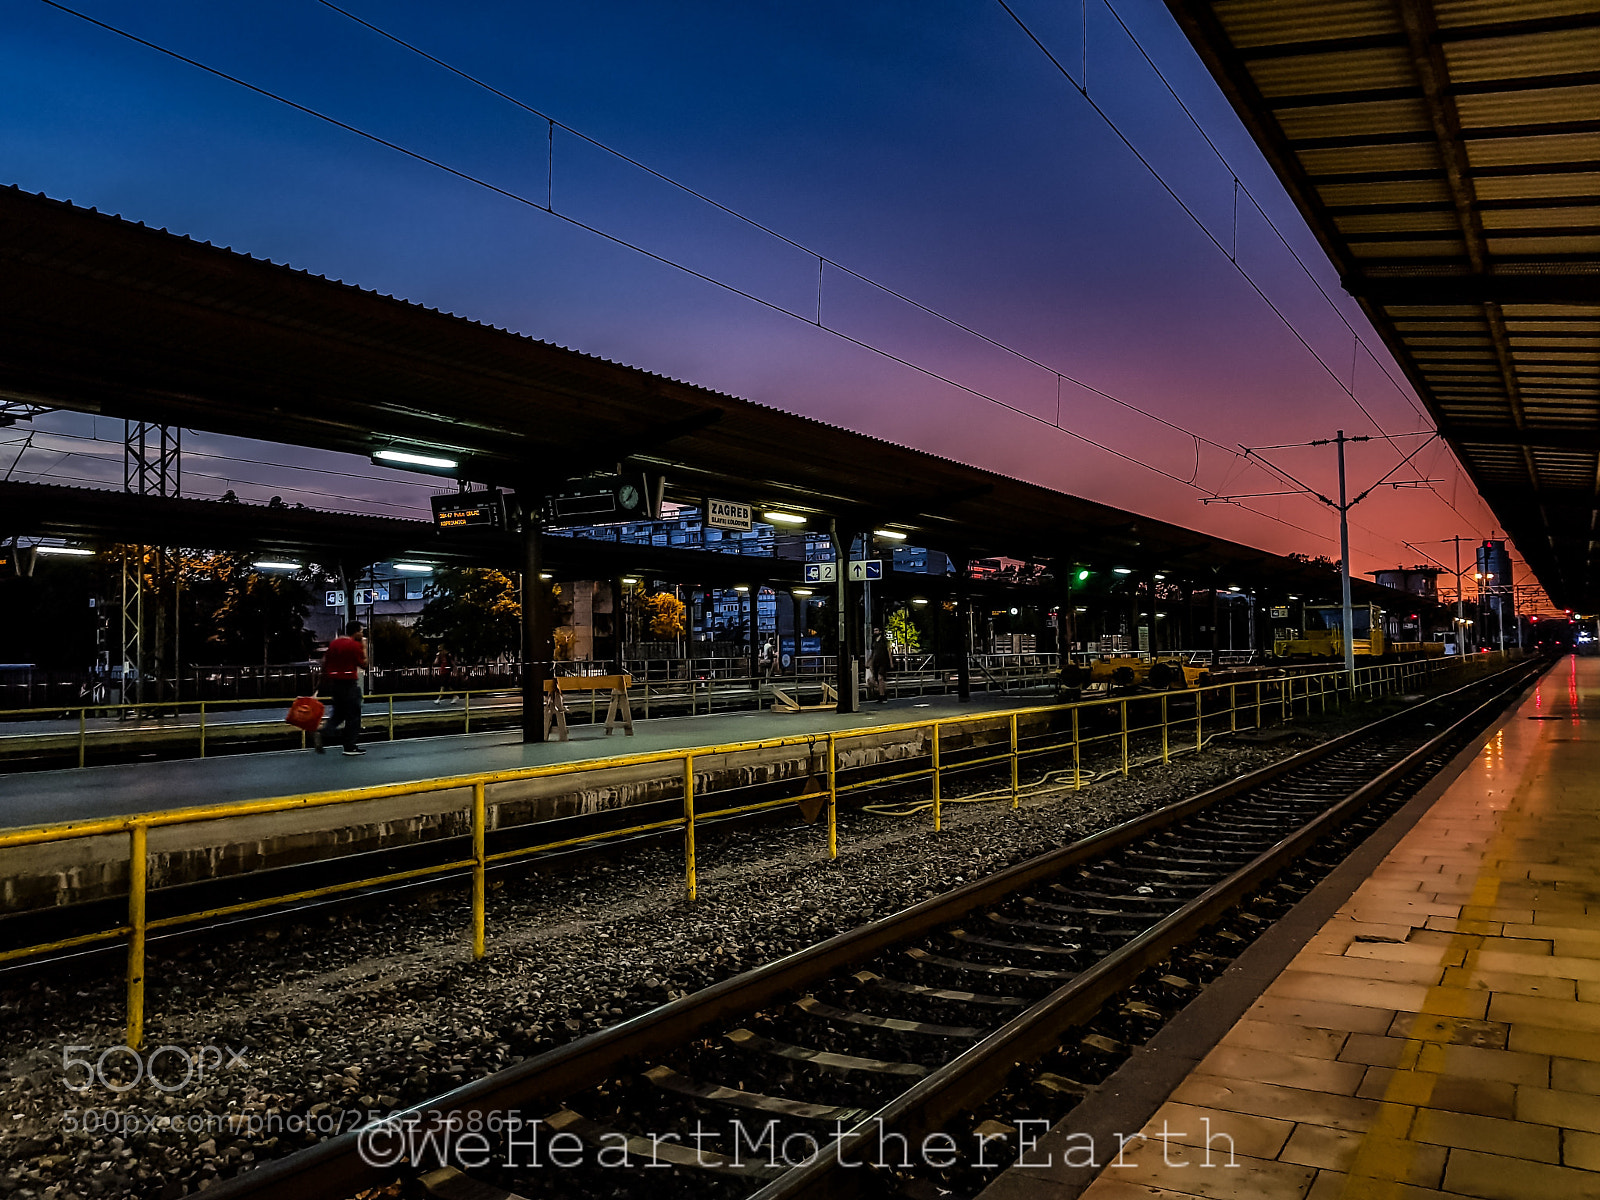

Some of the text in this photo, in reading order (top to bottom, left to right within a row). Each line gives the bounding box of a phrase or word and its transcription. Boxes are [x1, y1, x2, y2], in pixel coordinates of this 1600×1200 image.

[711, 503, 749, 518] ZAGREB
[824, 566, 832, 578] 2
[338, 593, 343, 602] 3
